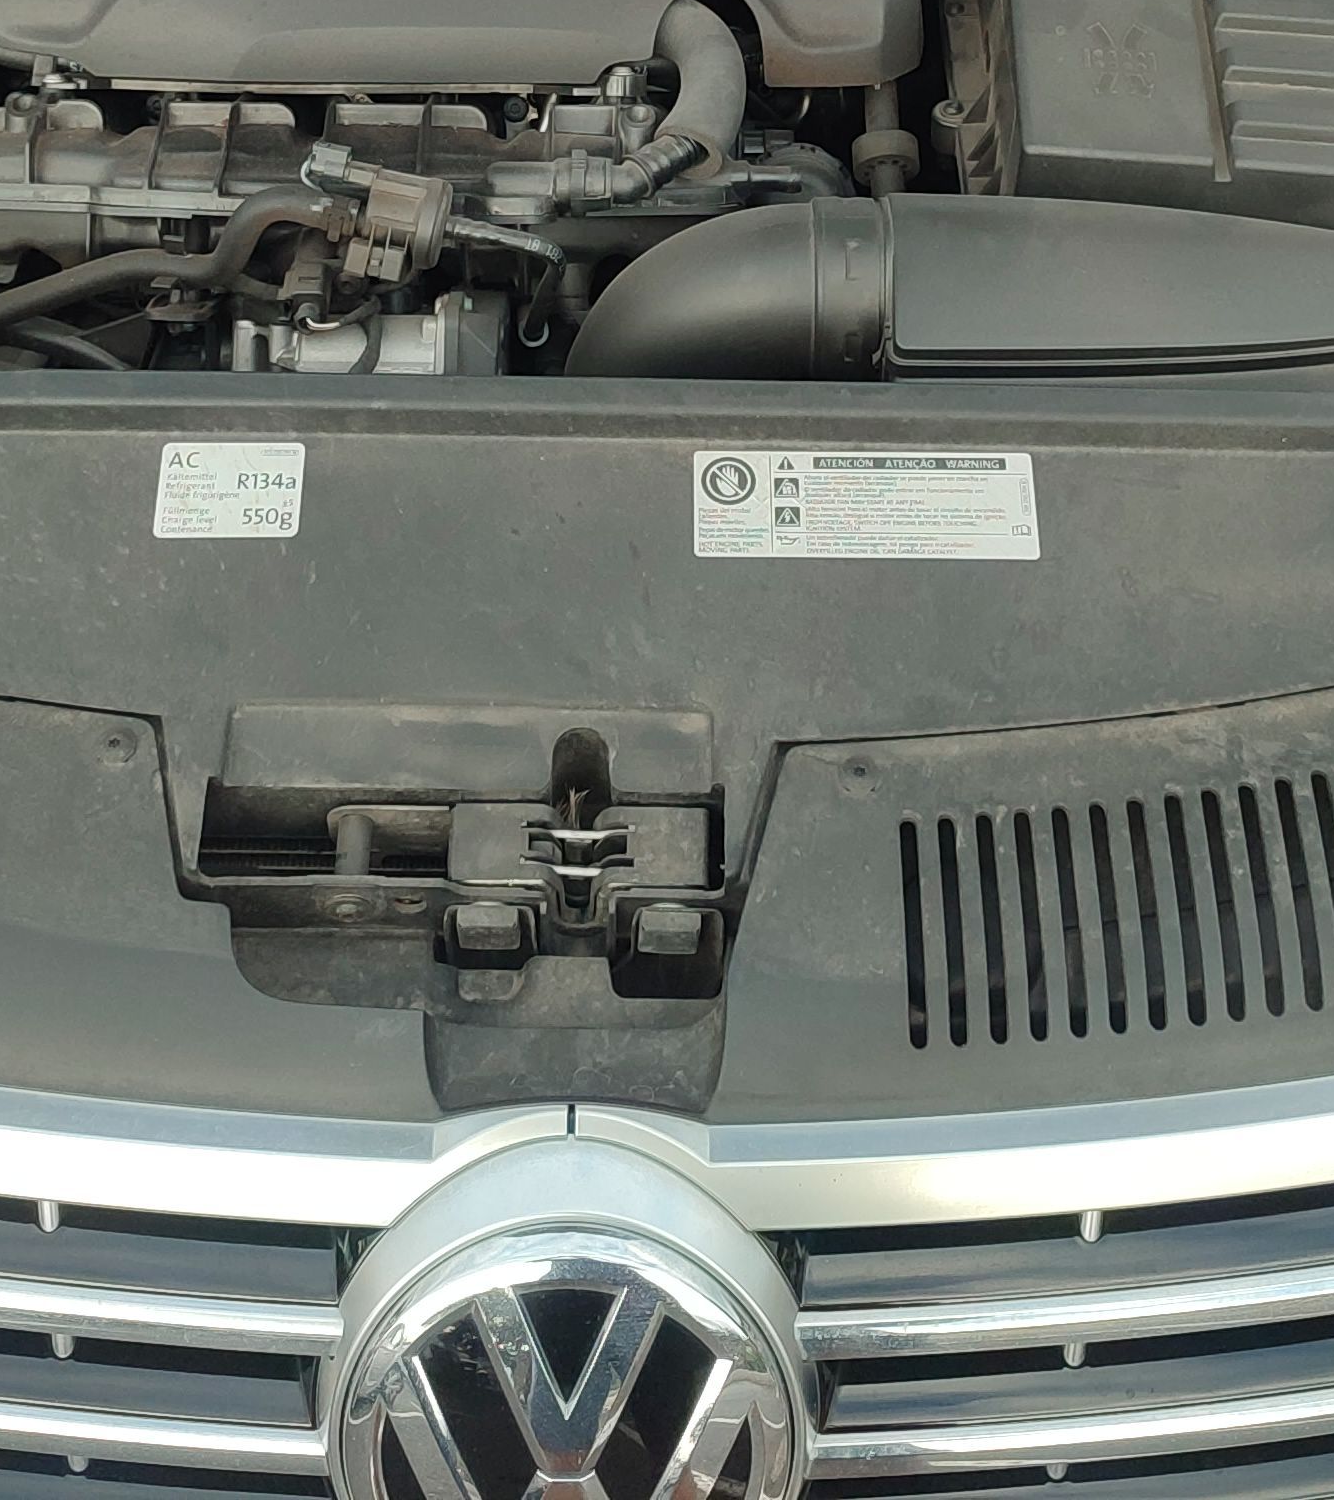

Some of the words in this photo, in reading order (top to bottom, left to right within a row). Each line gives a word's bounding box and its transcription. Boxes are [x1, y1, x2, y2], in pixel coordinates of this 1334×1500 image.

[168, 452, 201, 469] AC
[819, 458, 875, 468] ATENCIÓN
[945, 460, 1000, 469] WARNING
[165, 482, 216, 491] Refrigerant
[237, 472, 297, 490] R134a
[242, 508, 293, 530] 550g
